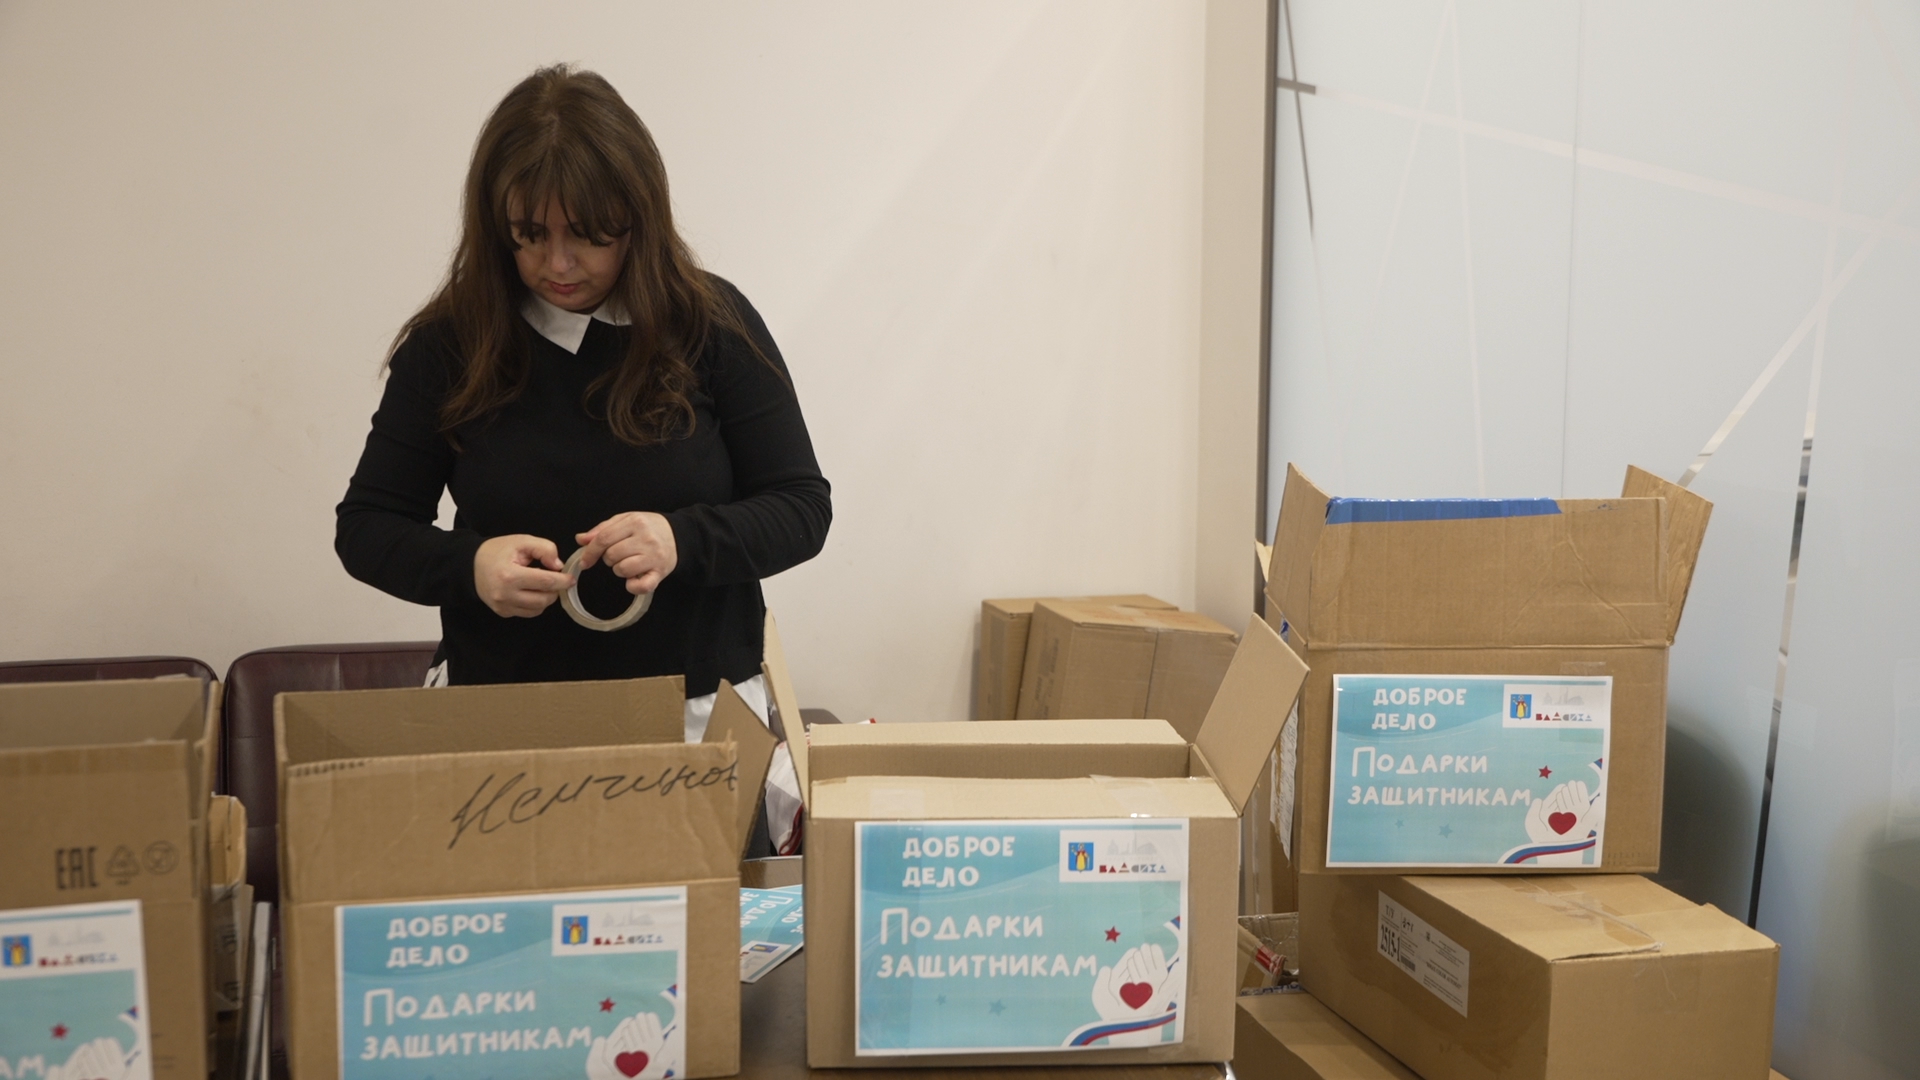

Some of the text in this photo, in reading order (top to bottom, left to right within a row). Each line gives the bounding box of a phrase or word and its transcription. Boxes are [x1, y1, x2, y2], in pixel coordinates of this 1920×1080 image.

[1373, 686, 1467, 706] ДОБРОЕ
[1371, 712, 1436, 731] ДЕЛО
[1347, 785, 1532, 806] ЗАЩИТНИКАМ
[902, 836, 1015, 859] ДОБРОЕ
[902, 865, 980, 888] ДЕЛО
[386, 913, 507, 940] ДОБРОЕ
[386, 944, 469, 969] ДЕЛО
[877, 953, 1098, 978] ЗАЩИТНИКАМ
[360, 1025, 592, 1060] ЗАЩИТНИКАМ
